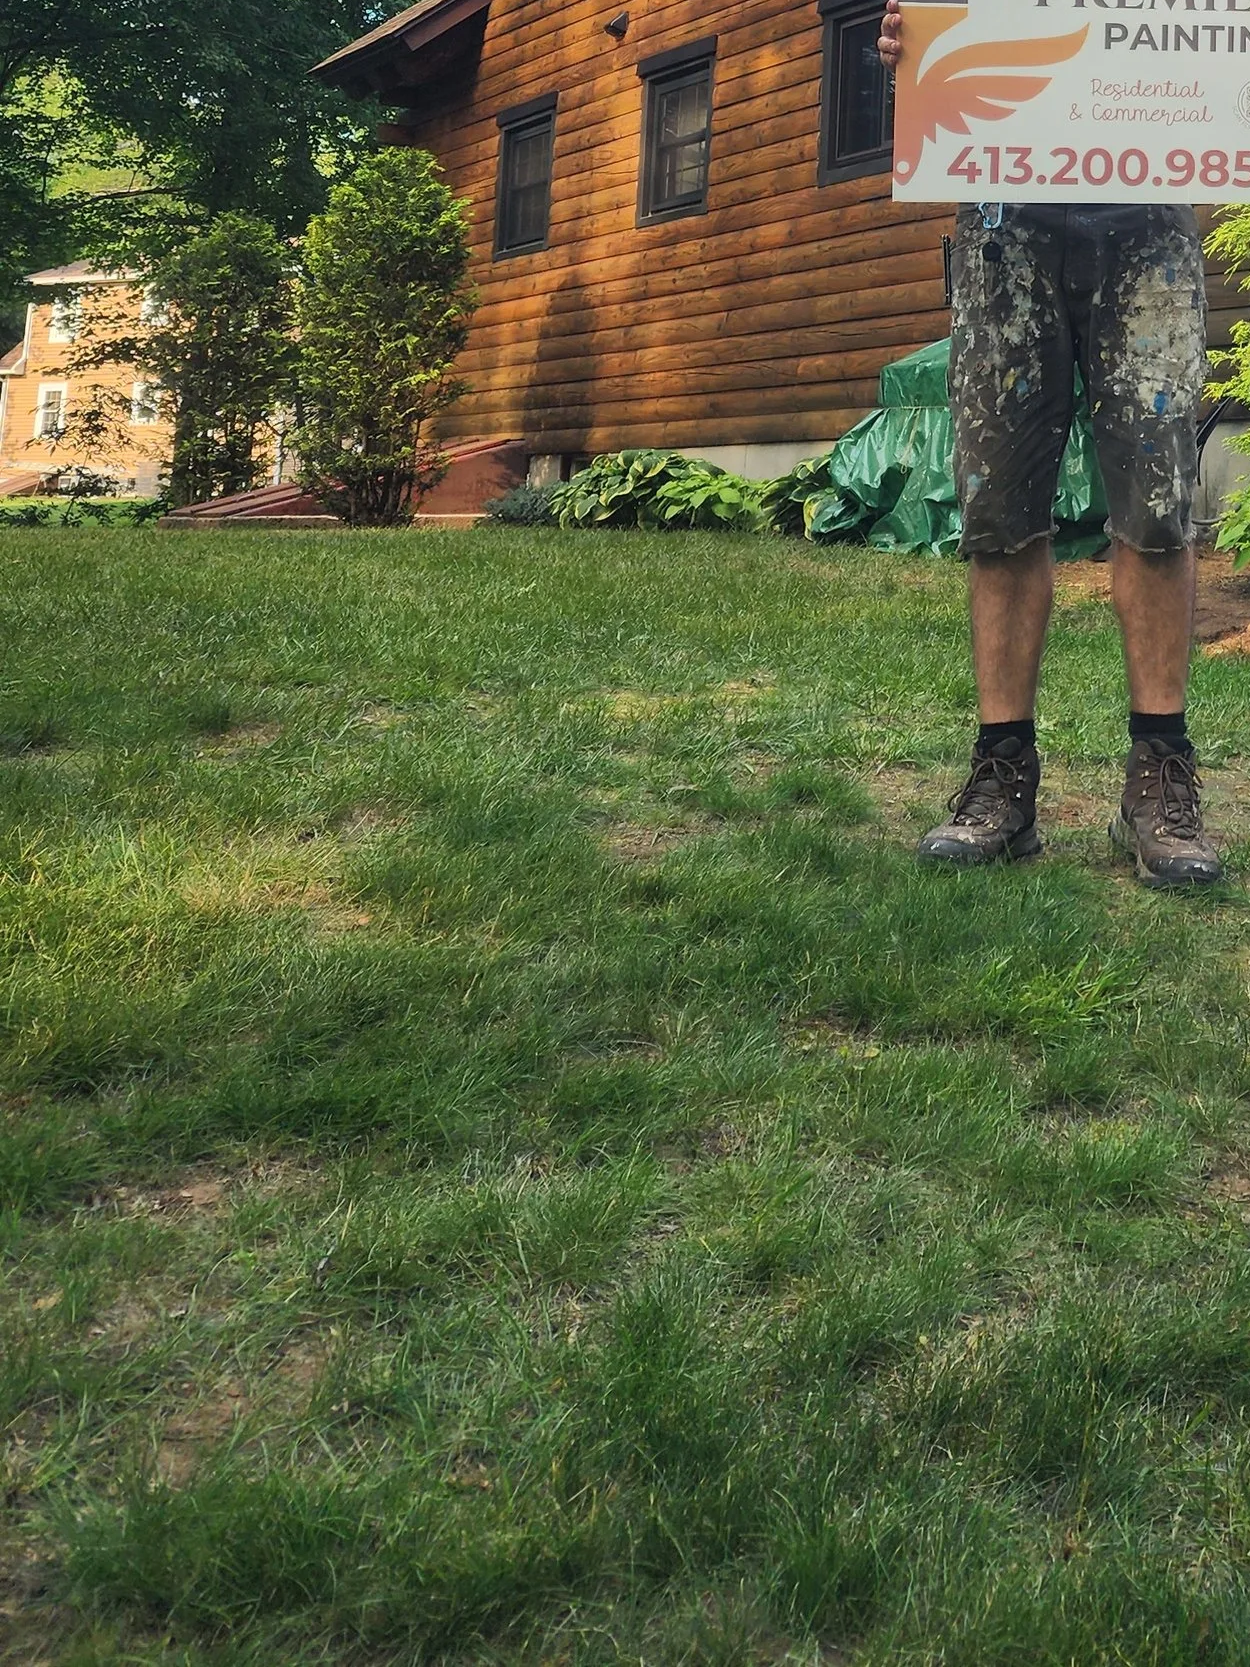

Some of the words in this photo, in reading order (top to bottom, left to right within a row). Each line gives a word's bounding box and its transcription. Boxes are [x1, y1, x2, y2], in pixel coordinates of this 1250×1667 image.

[1090, 78, 1205, 102] Residential
[1069, 102, 1082, 122] &
[1091, 103, 1214, 127] Commercial
